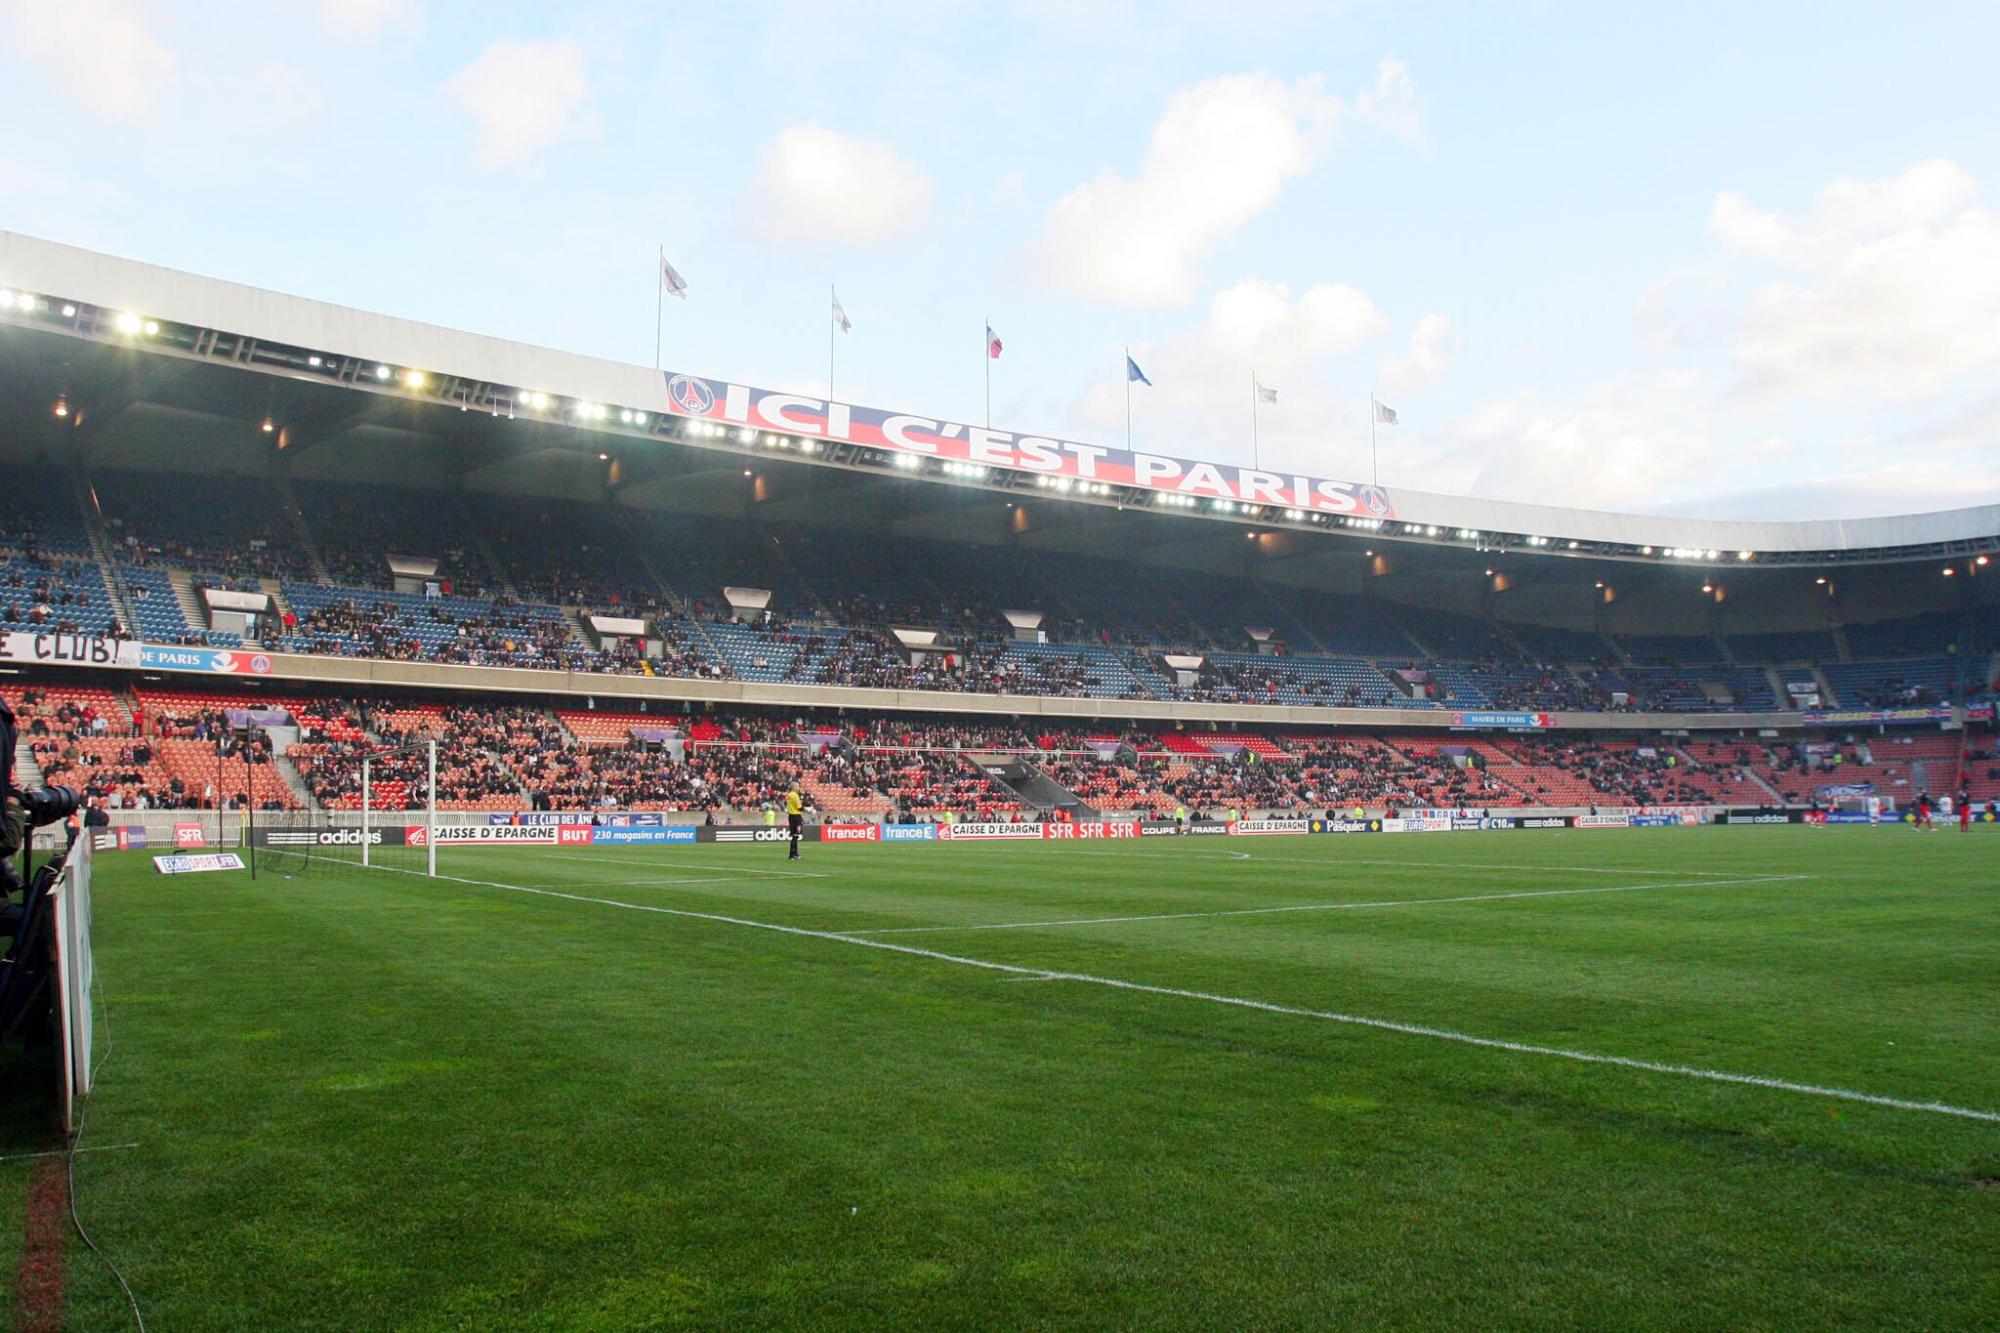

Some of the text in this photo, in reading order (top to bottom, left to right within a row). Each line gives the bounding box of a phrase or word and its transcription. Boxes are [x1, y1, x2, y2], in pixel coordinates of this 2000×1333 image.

[724, 383, 1357, 512] ICI C'EST PARIS
[34, 632, 120, 664] CLUB!
[160, 652, 200, 665] PARIS
[527, 814, 537, 825] LE
[539, 814, 560, 825] CLUB
[561, 815, 575, 825] DES
[1754, 814, 1789, 823] adidas
[952, 824, 1041, 834] CAISSE D'EPARGNE
[1048, 822, 1134, 839] SFR SFR SFR
[1141, 825, 1227, 835] COUPE FRANCE
[1239, 821, 1265, 830] CAISSE
[179, 828, 203, 842] SFR
[481, 827, 555, 839] D'EPARGNE
[562, 830, 694, 842] BUT 230 magasins en France
